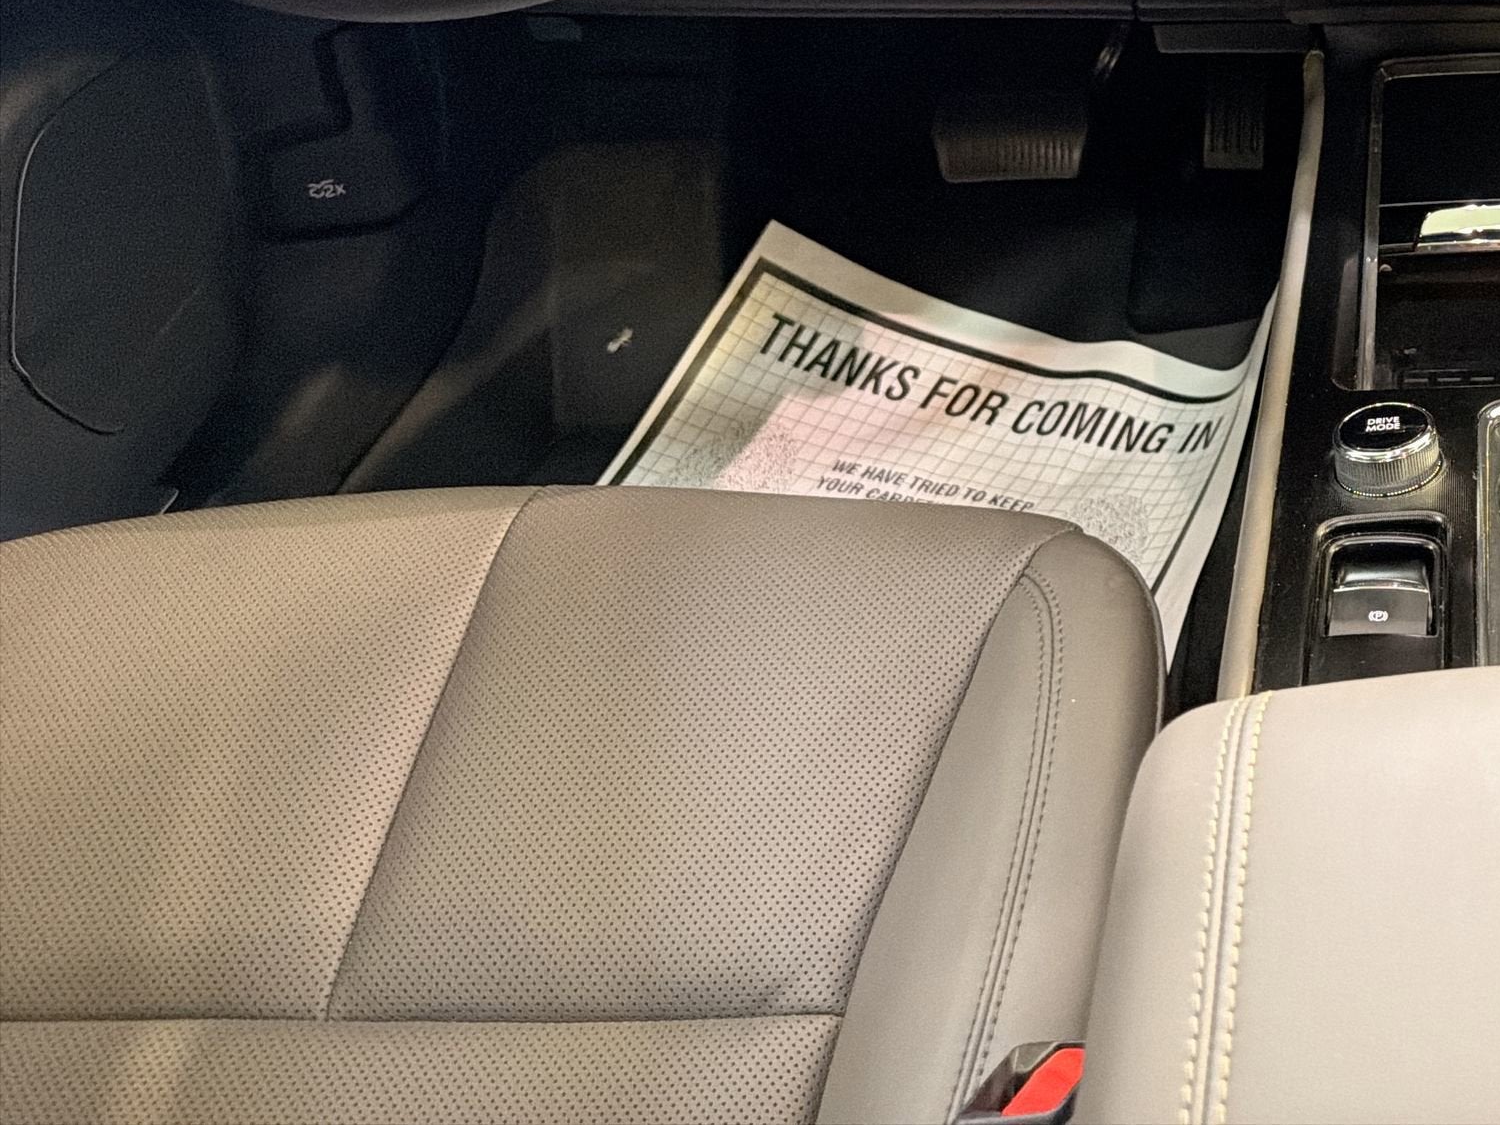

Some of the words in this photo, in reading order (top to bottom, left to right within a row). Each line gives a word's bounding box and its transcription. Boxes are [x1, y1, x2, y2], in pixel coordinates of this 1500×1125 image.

[759, 313, 921, 402] THANKS
[919, 376, 1010, 426] FOR
[1011, 399, 1175, 454] COMING
[1177, 416, 1223, 455] IN
[1365, 423, 1400, 432] MODE
[1367, 416, 1400, 425] DRIVE
[816, 476, 864, 496] YOUR
[832, 459, 861, 475] WE
[861, 467, 908, 486] HAVE
[909, 475, 960, 498] TRIED
[963, 487, 987, 502] TO
[988, 493, 1035, 511] KEEP
